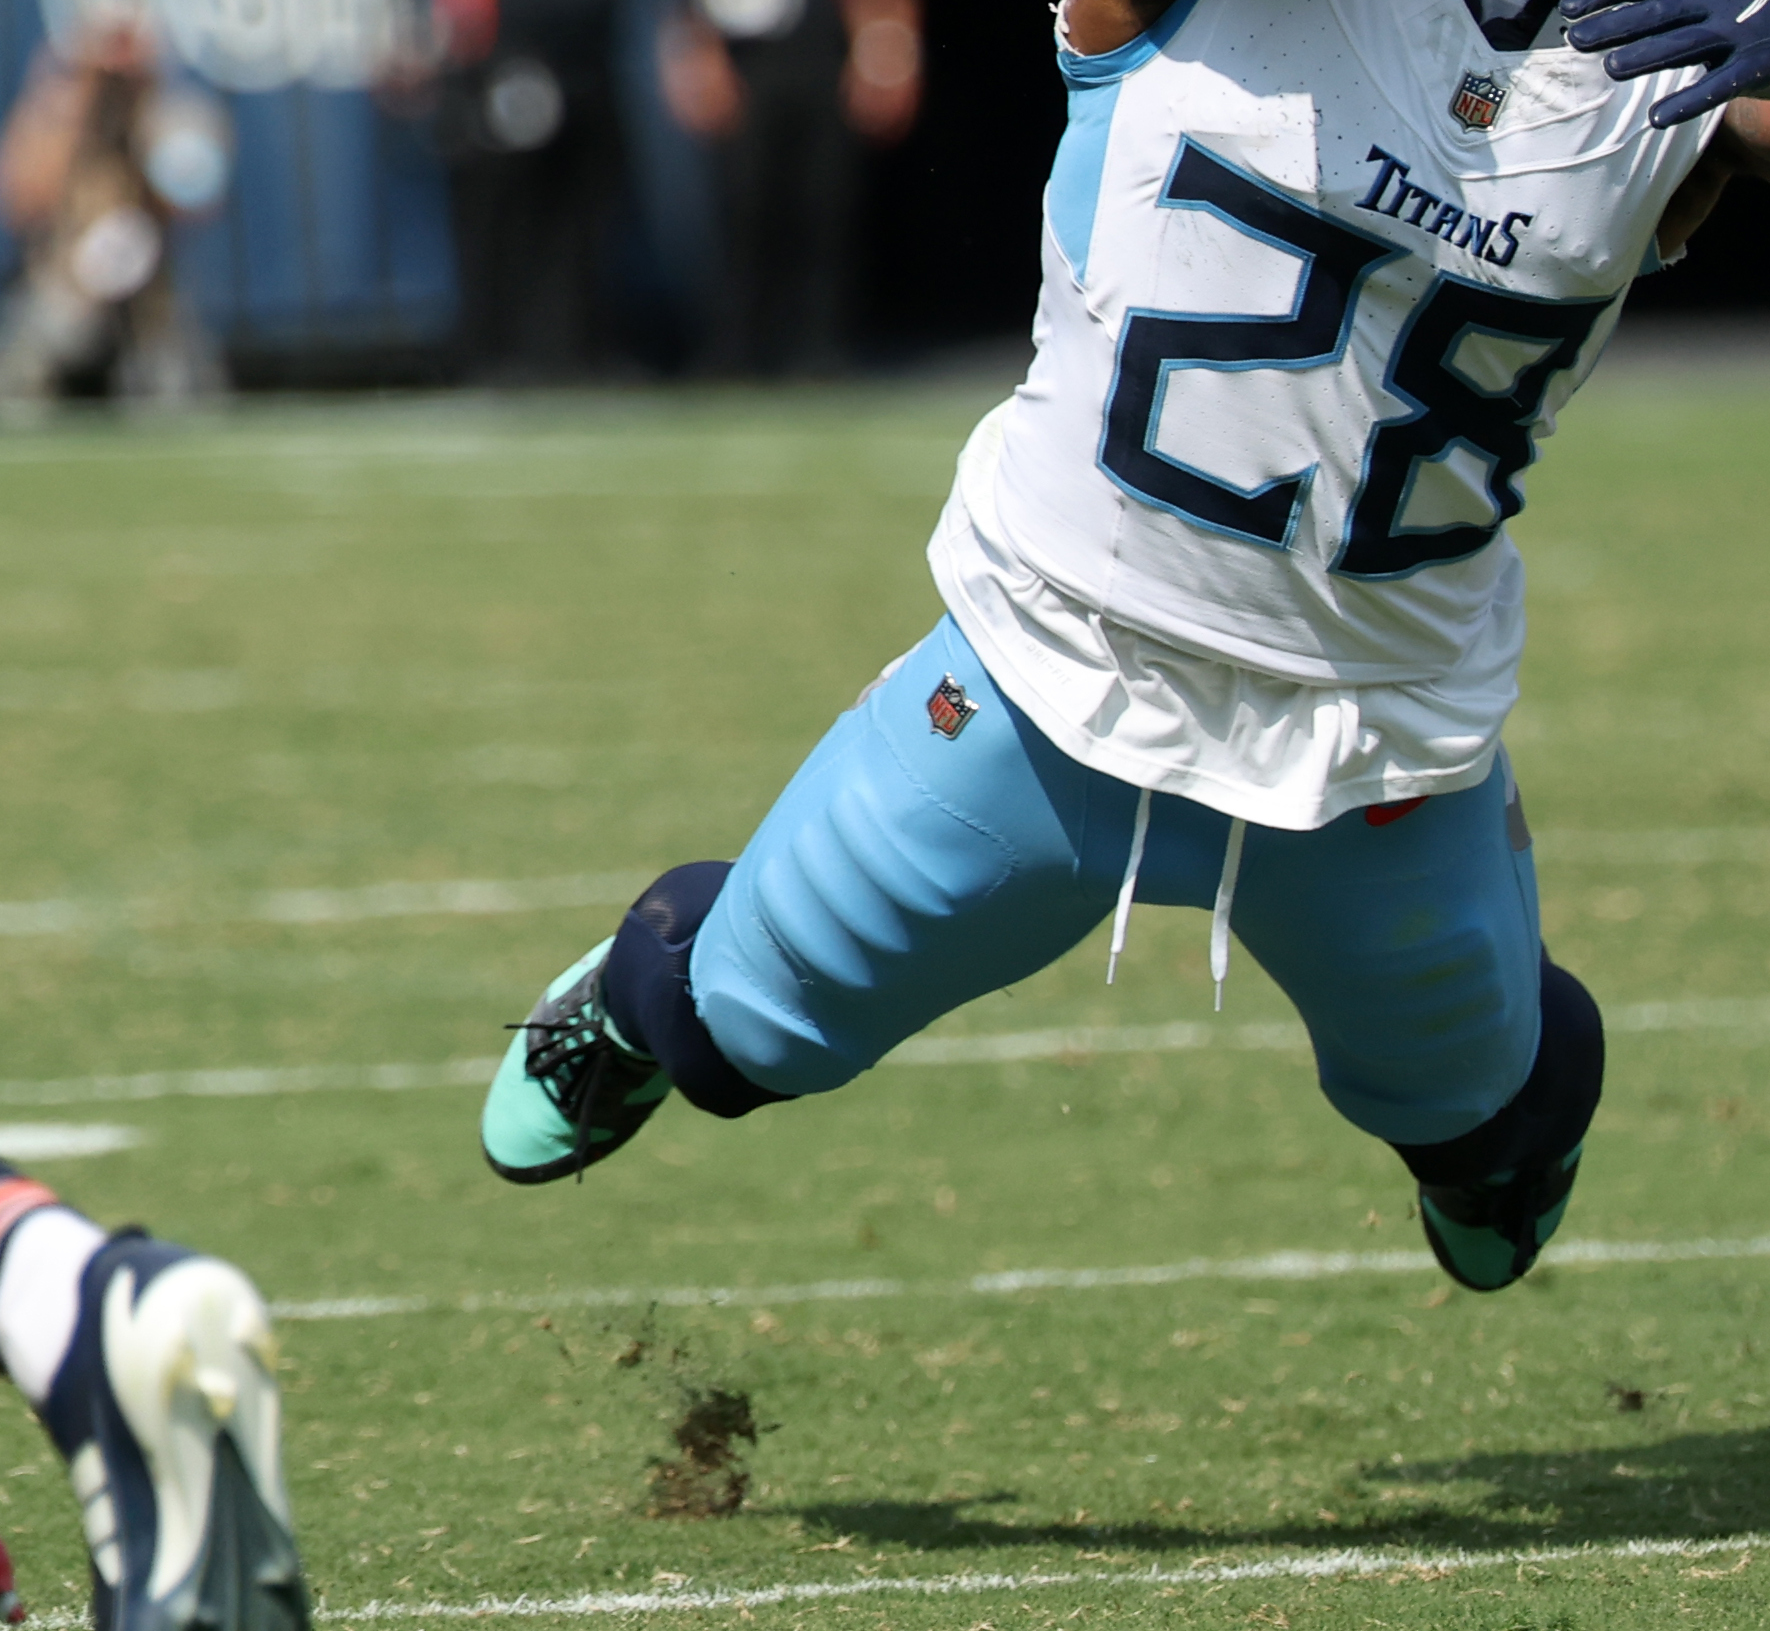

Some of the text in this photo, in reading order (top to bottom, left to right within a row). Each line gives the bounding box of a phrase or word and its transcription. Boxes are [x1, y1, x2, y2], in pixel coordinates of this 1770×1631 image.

[1456, 91, 1495, 125] NFL
[1353, 143, 1535, 267] TITANS
[1096, 132, 1626, 582] 28
[930, 692, 961, 733] NFL
